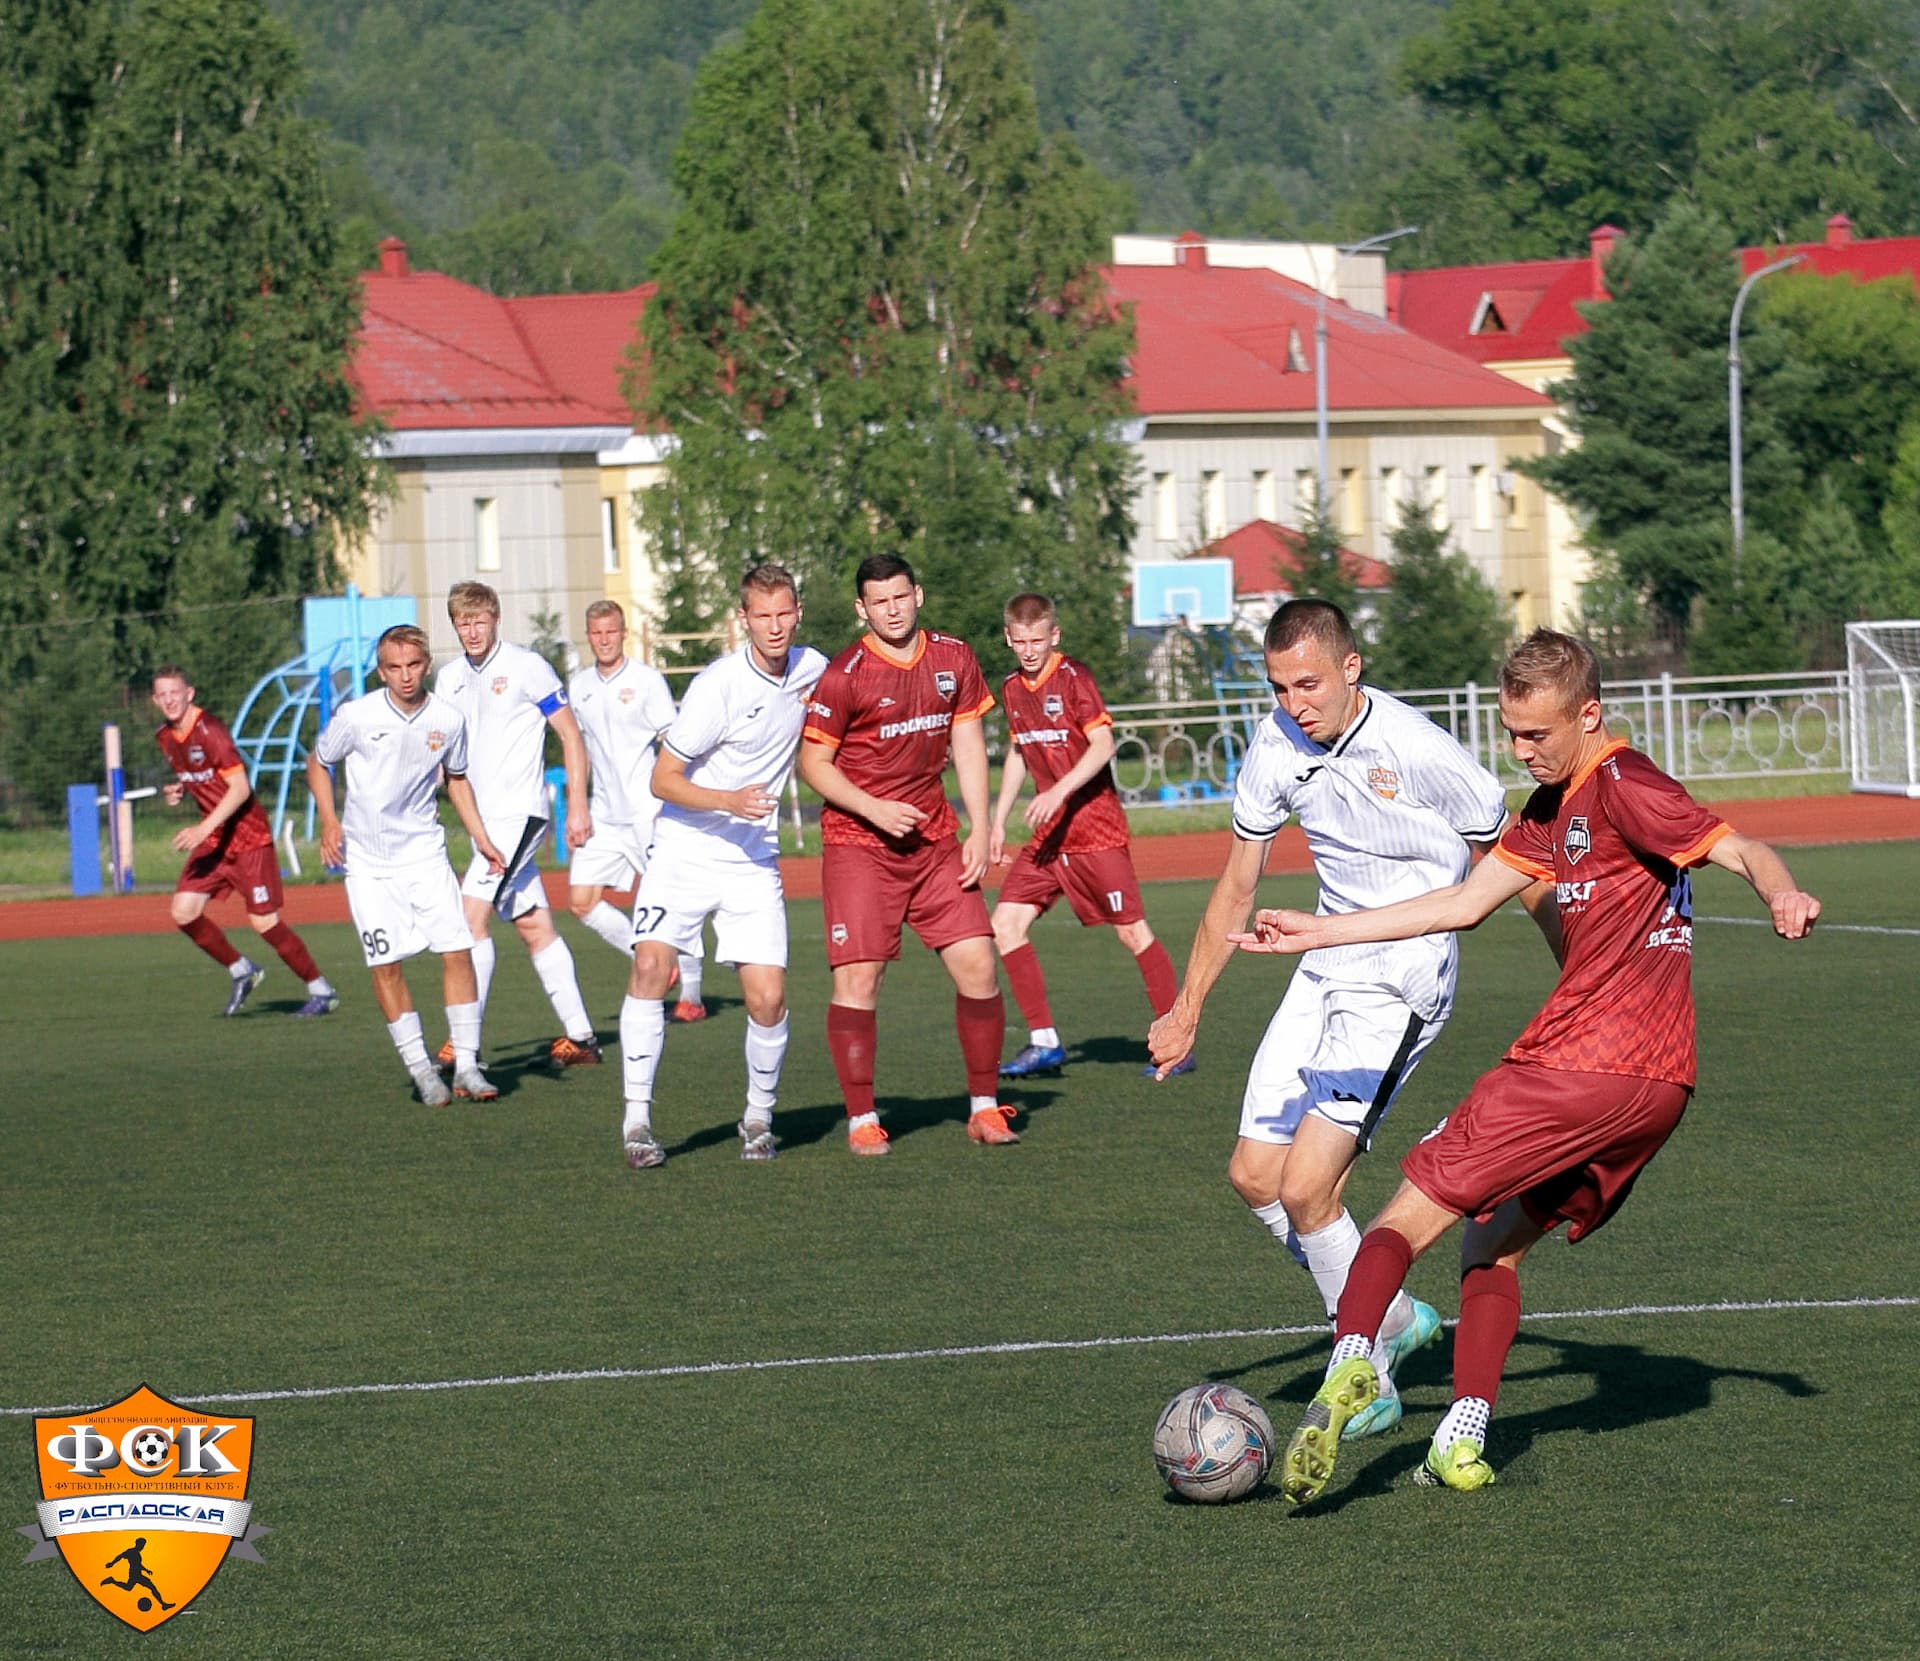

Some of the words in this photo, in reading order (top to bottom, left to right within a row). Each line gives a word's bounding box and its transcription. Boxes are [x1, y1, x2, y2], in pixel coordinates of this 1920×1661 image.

[1106, 890, 1122, 912] 17
[634, 905, 667, 936] 27
[362, 928, 391, 958] 96
